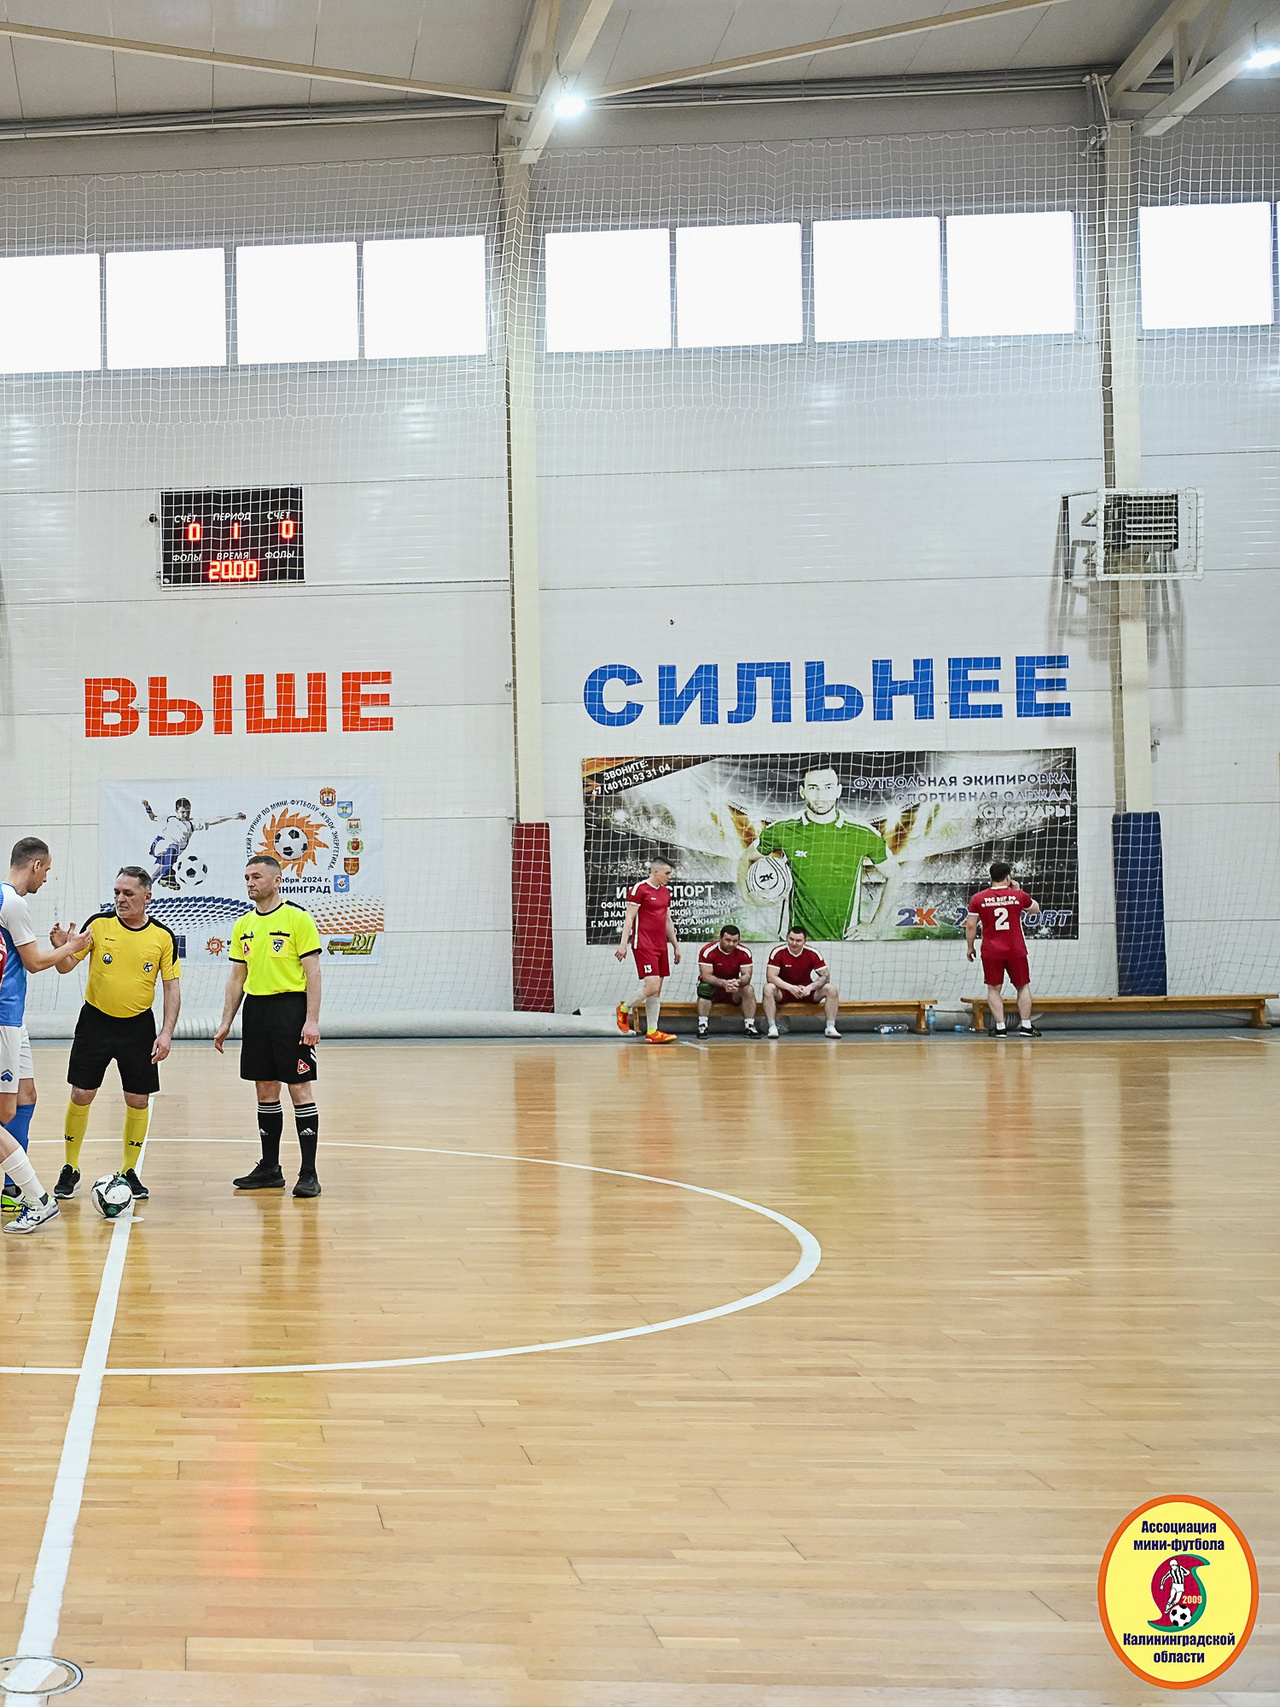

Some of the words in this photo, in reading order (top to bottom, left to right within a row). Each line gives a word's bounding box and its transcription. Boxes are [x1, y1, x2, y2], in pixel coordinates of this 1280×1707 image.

[213, 512, 251, 521] ПЕРИОД
[188, 523, 201, 541] 0
[233, 522, 239, 539] 1
[282, 520, 294, 538] 0
[172, 553, 202, 562] ФОЛЫ
[217, 551, 249, 560] ВРЕМЯ
[265, 550, 295, 559] ФОЛЫ
[583, 655, 1071, 727] СИЛЬНЕЕ
[84, 671, 394, 738] ВЫШЕ
[603, 760, 649, 781] ЗВОНИТЕ:
[604, 777, 632, 793] (4012)
[633, 772, 645, 782] 93
[646, 767, 657, 778] 31
[658, 763, 671, 773] 04
[854, 775, 957, 789] ФУТБОЛЬНАЯ
[963, 772, 1070, 786] ЭКИПИРОВКА
[894, 791, 997, 804] СПОРТИВНАЯ
[1003, 789, 1071, 801] ОДЕЖДА
[247, 813, 261, 836] ТУРНИР
[261, 807, 271, 816] ПО
[302, 876, 322, 884] 2024
[279, 886, 331, 895] НИНГРАД
[895, 907, 939, 927] 2K
[994, 907, 1010, 930] 2
[1020, 909, 1072, 927] PORT
[644, 964, 652, 974] 13
